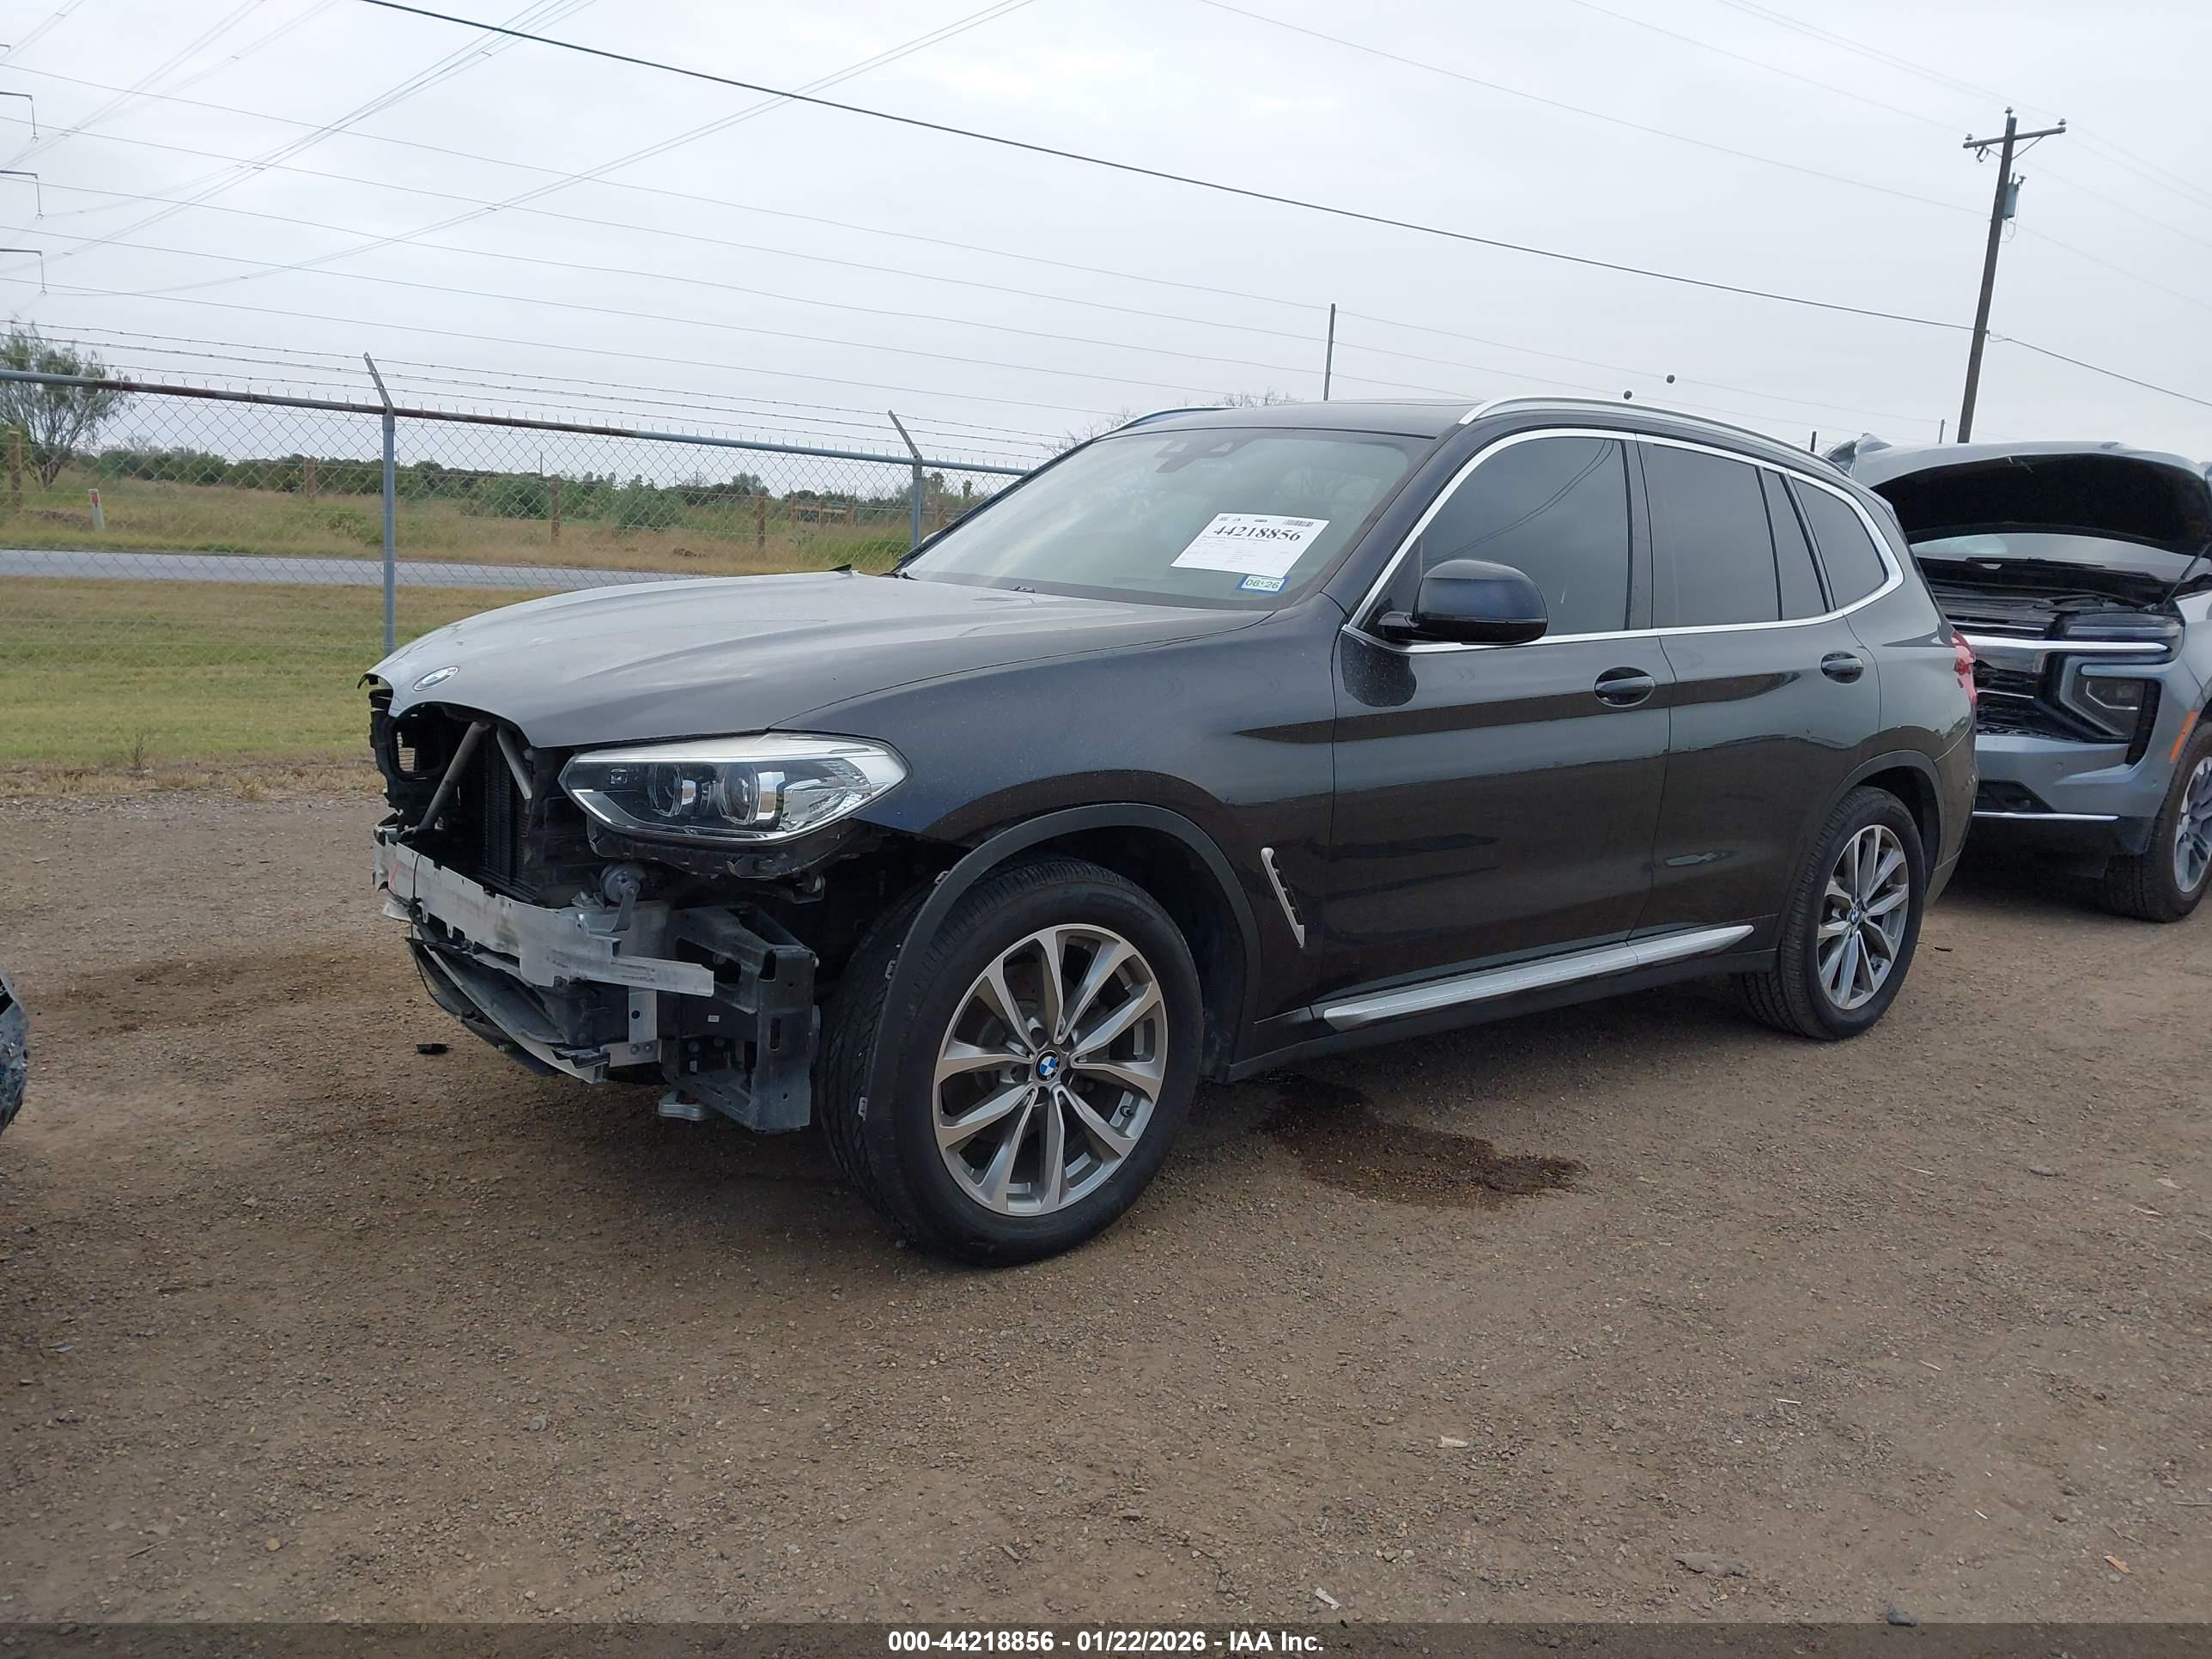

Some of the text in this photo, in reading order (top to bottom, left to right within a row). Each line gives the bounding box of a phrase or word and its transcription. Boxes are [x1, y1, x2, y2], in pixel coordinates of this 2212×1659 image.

[1213, 526, 1303, 541] 44218856
[1245, 579, 1261, 587] 06
[1264, 580, 1279, 589] 26
